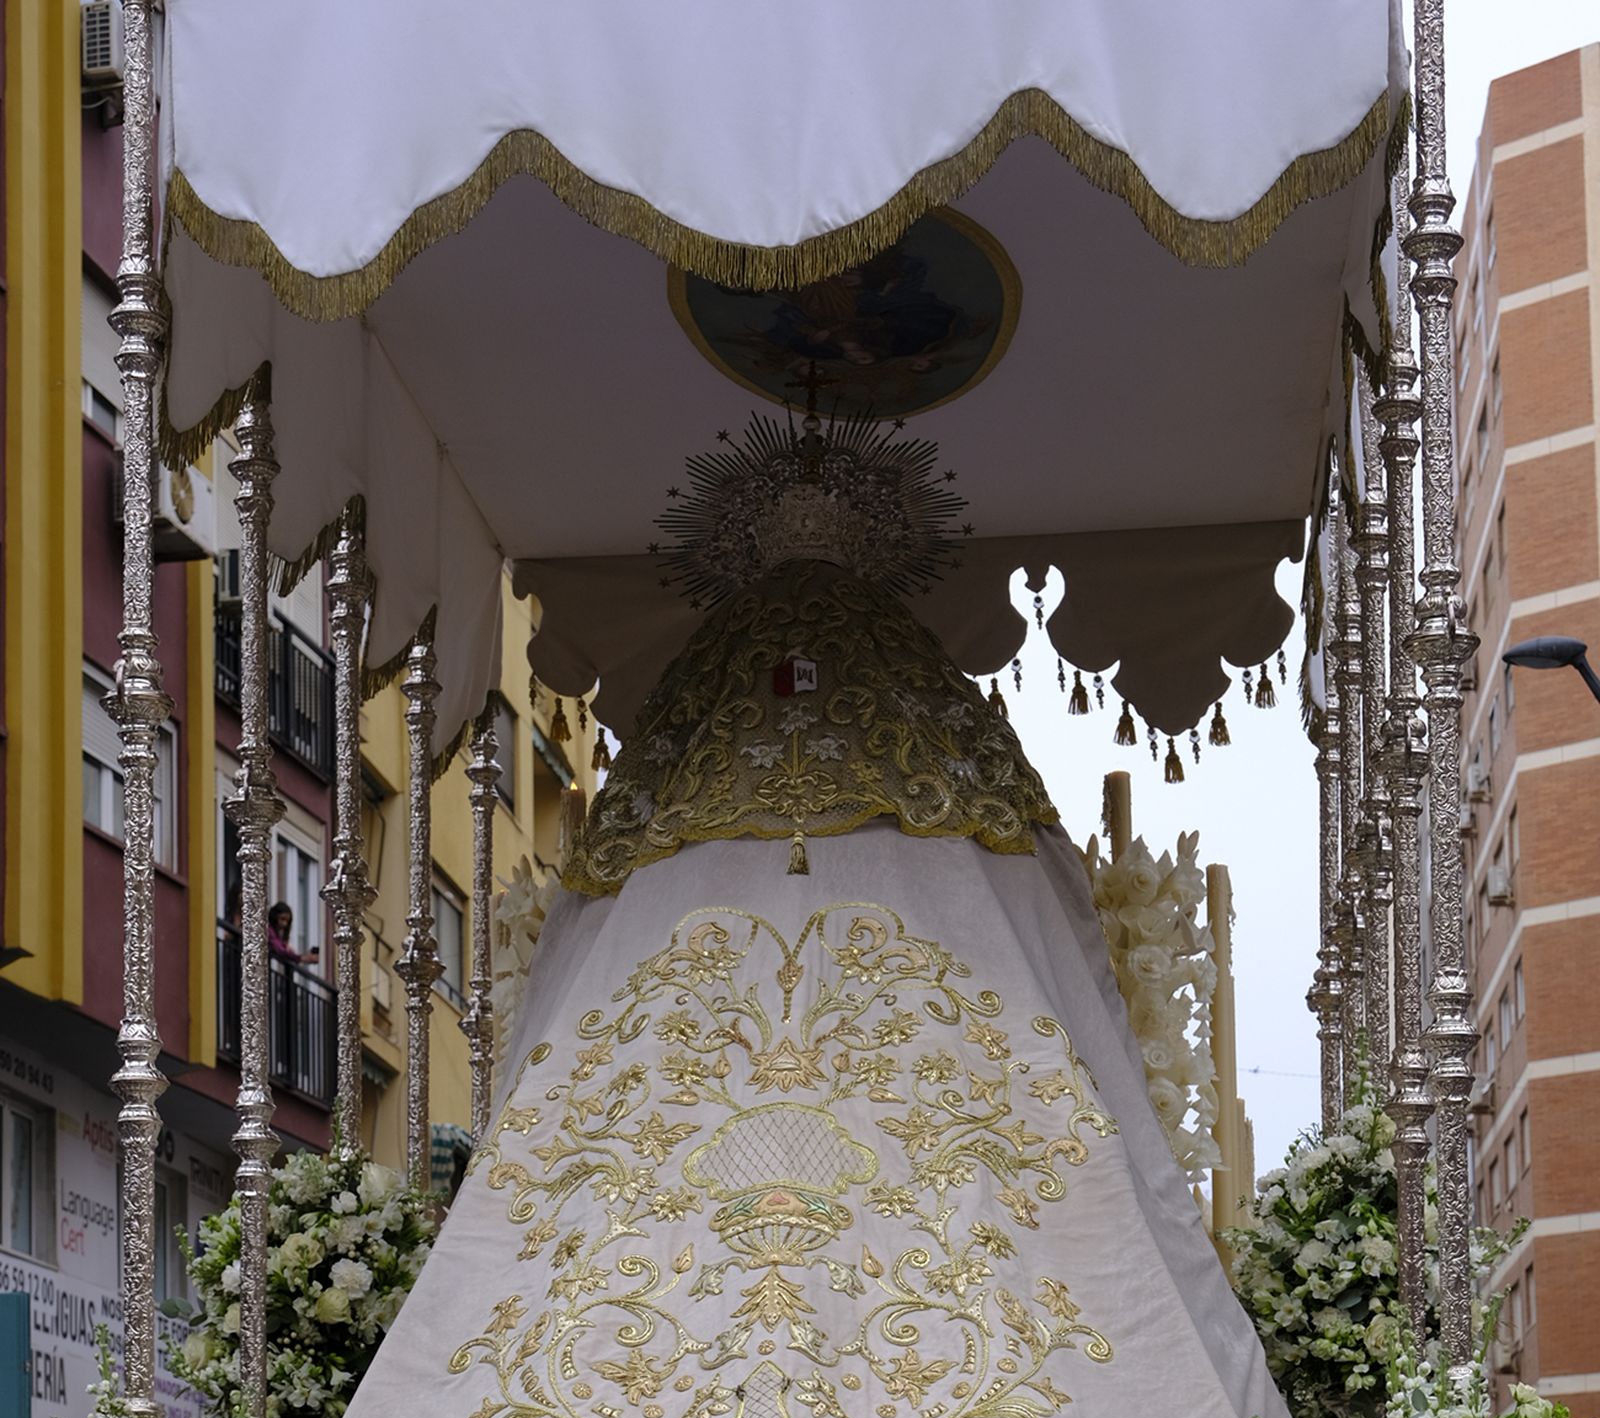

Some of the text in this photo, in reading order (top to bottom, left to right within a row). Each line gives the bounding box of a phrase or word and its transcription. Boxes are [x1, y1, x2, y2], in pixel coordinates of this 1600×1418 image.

[83, 1112, 114, 1154] Aptis
[61, 1178, 114, 1236] Language
[61, 1216, 86, 1256] Cert
[32, 1345, 67, 1405] ERÍA
